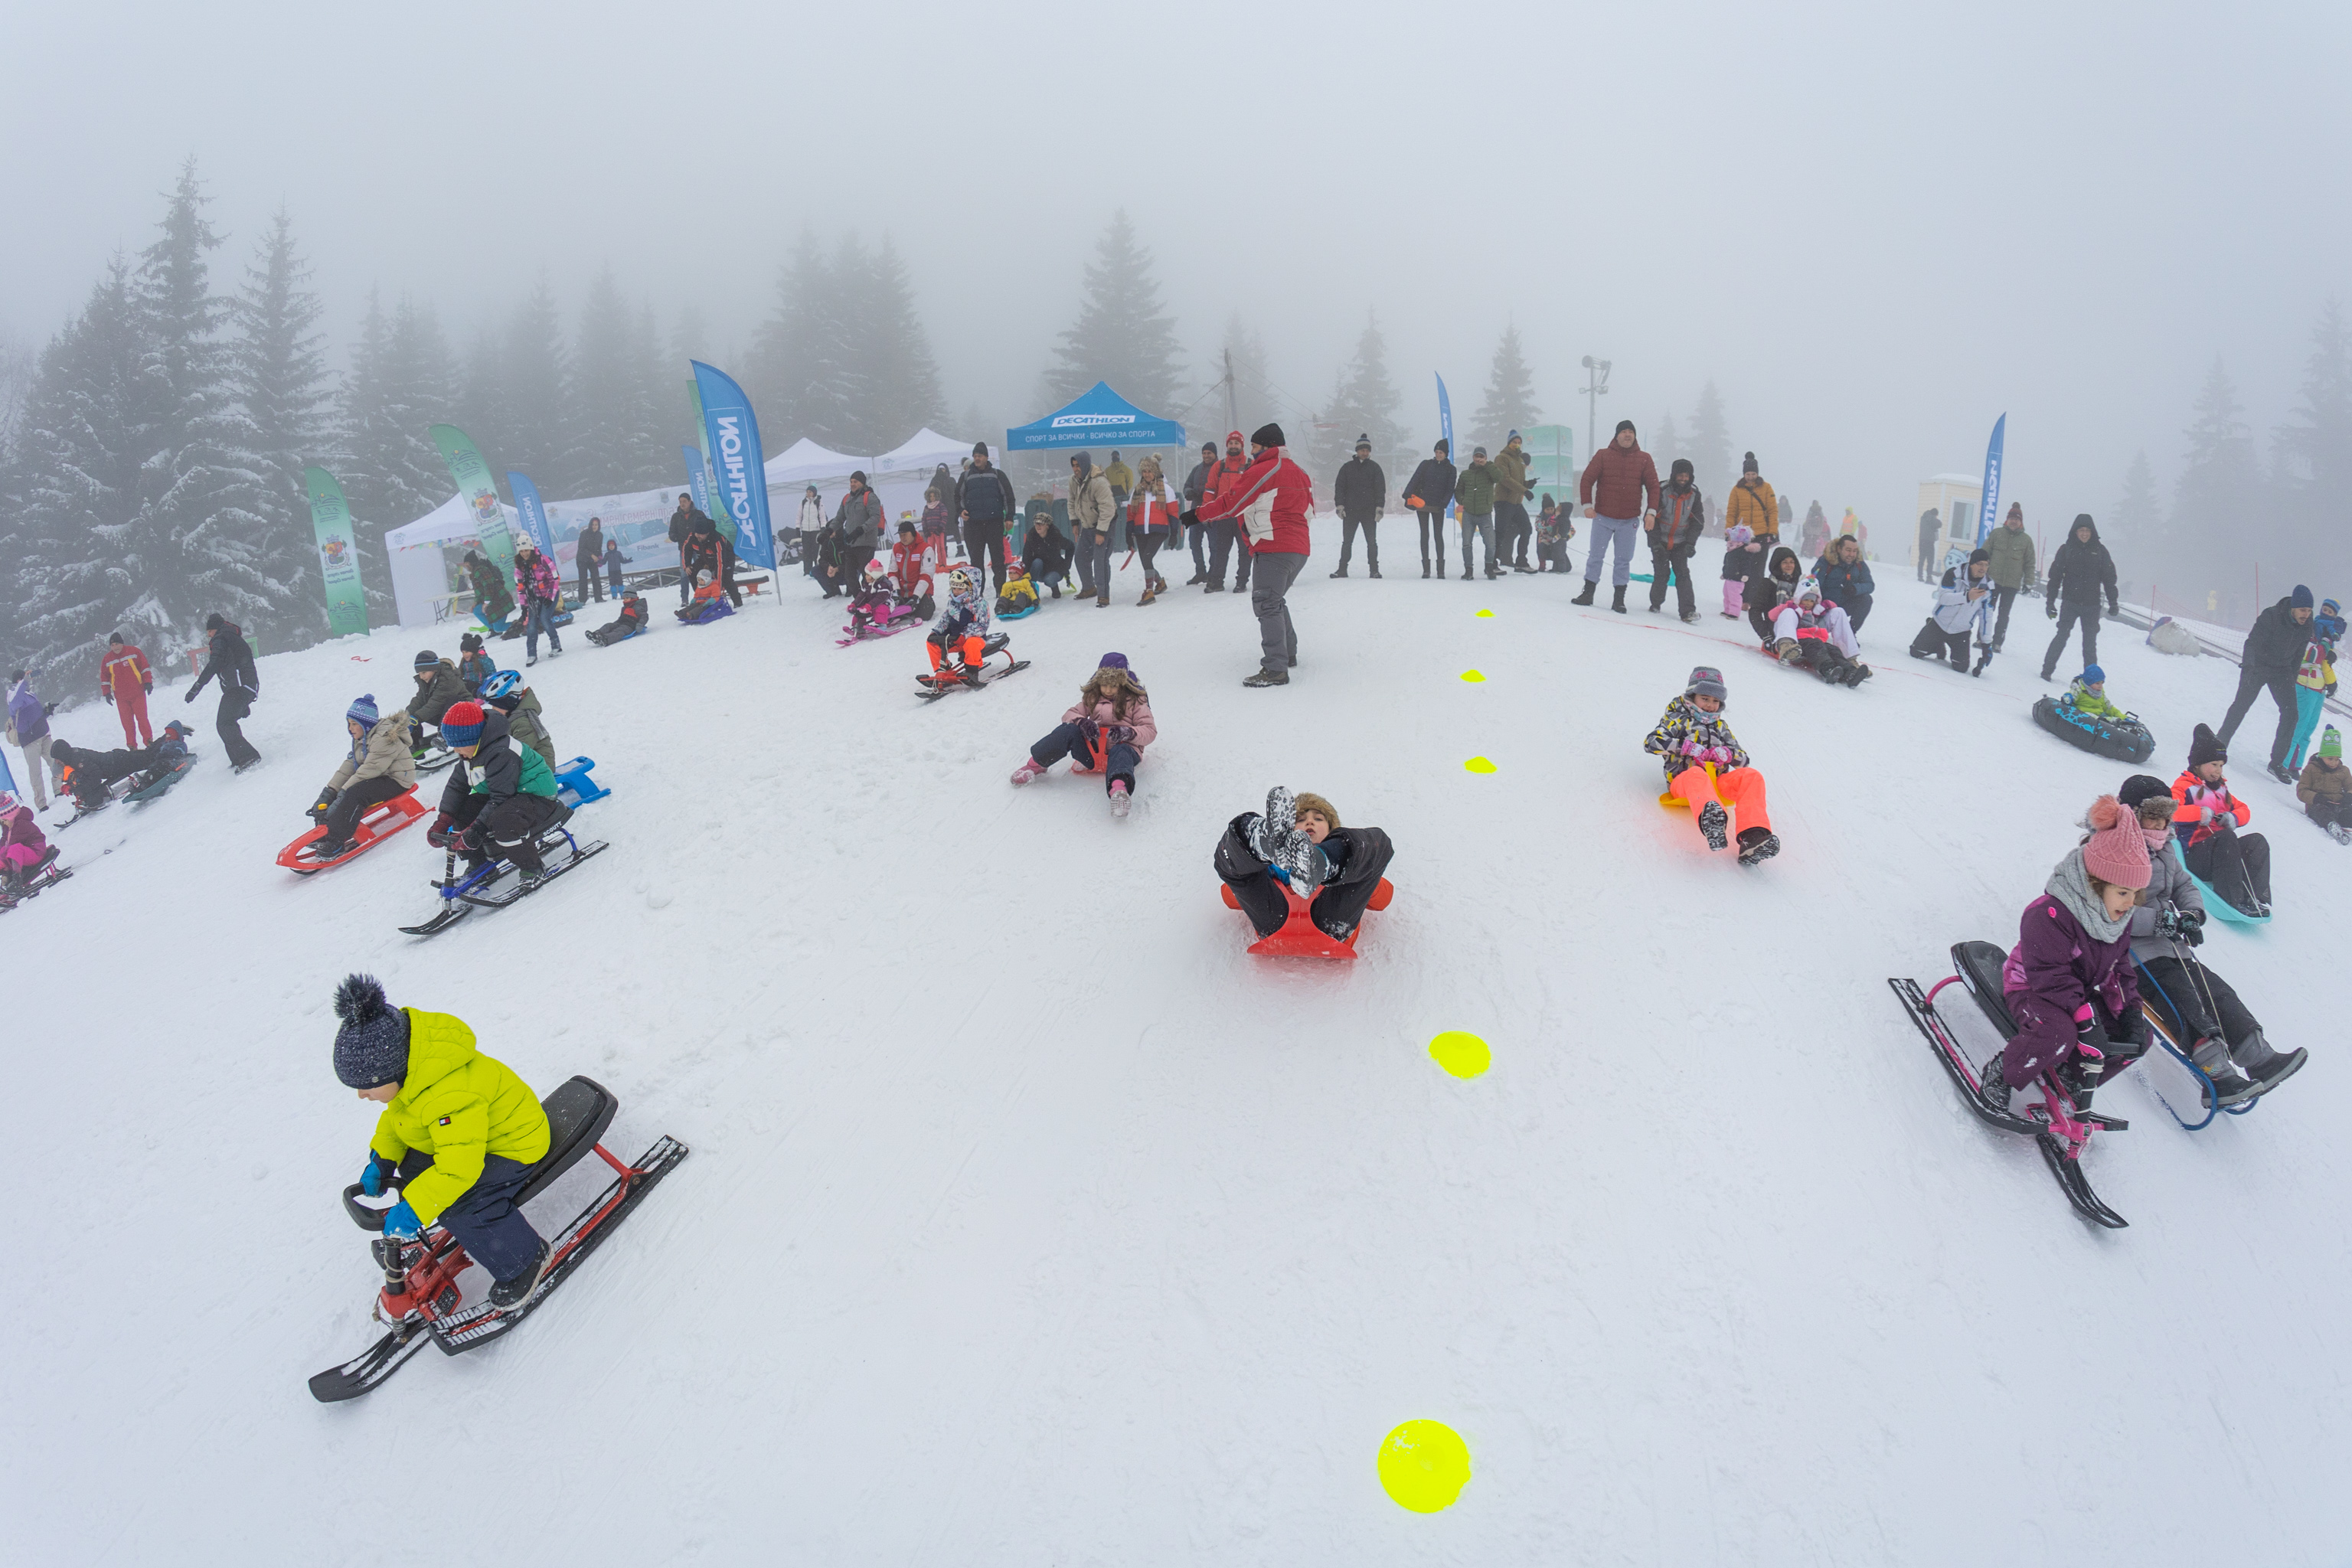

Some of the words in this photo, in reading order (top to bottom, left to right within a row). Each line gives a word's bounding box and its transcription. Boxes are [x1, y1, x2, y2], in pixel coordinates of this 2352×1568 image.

[1057, 417, 1130, 426] DECATHLON
[1025, 434, 1047, 443] СПОРТ
[1984, 460, 1998, 539] ATHLON
[543, 821, 562, 836] SCOUTT
